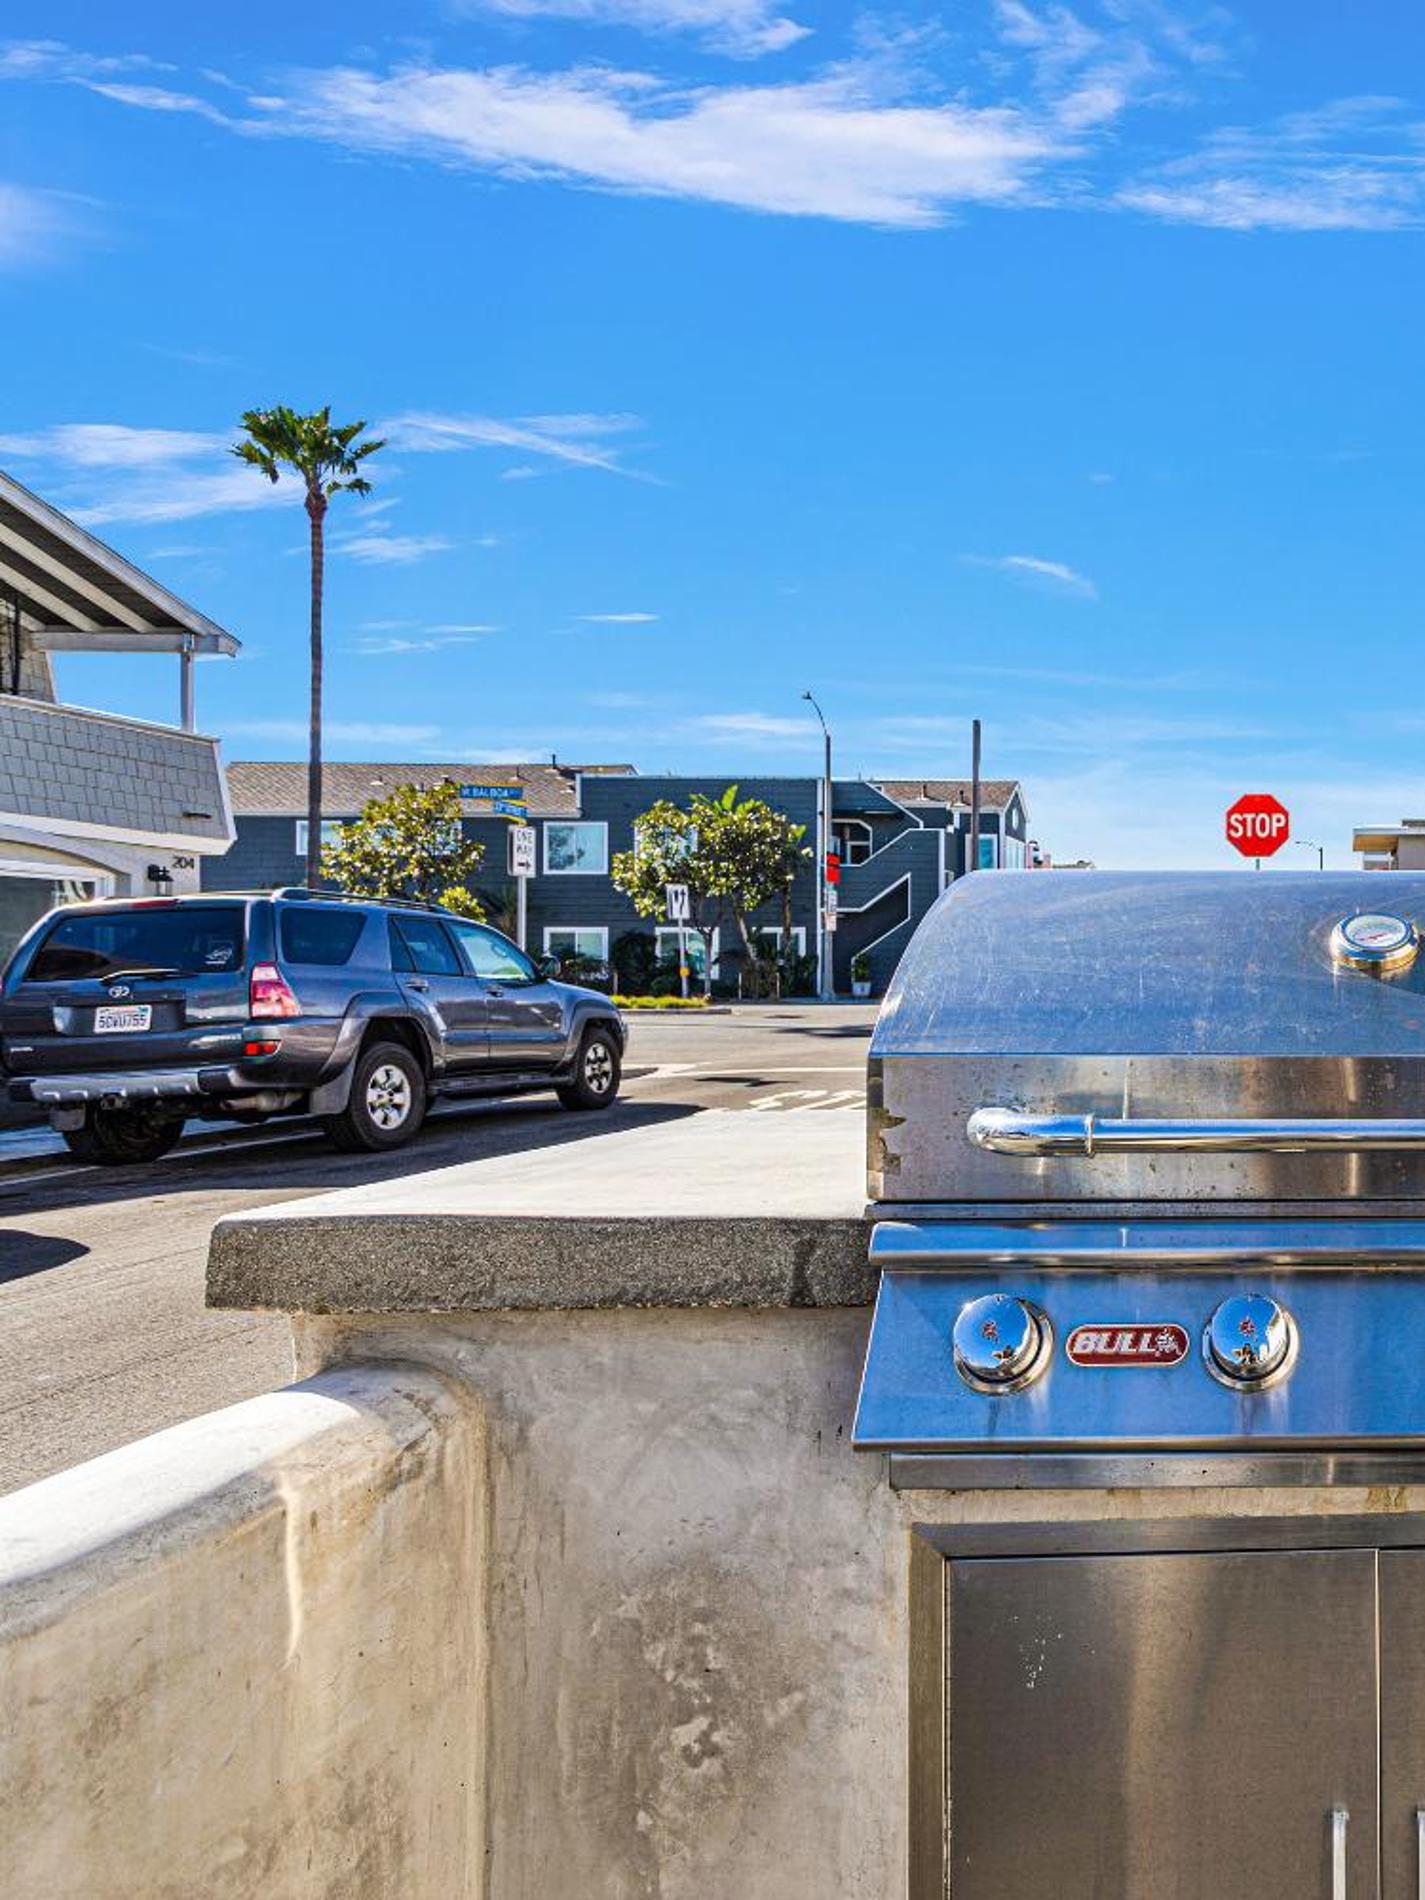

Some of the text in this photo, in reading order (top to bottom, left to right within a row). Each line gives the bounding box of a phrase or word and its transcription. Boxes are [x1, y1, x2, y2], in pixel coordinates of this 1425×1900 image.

[472, 786, 509, 798] BALBOA
[1229, 812, 1287, 839] STOP
[516, 830, 533, 844] ONE
[516, 844, 533, 856] WAY
[172, 855, 195, 870] 204
[1072, 1331, 1157, 1354] BULL
